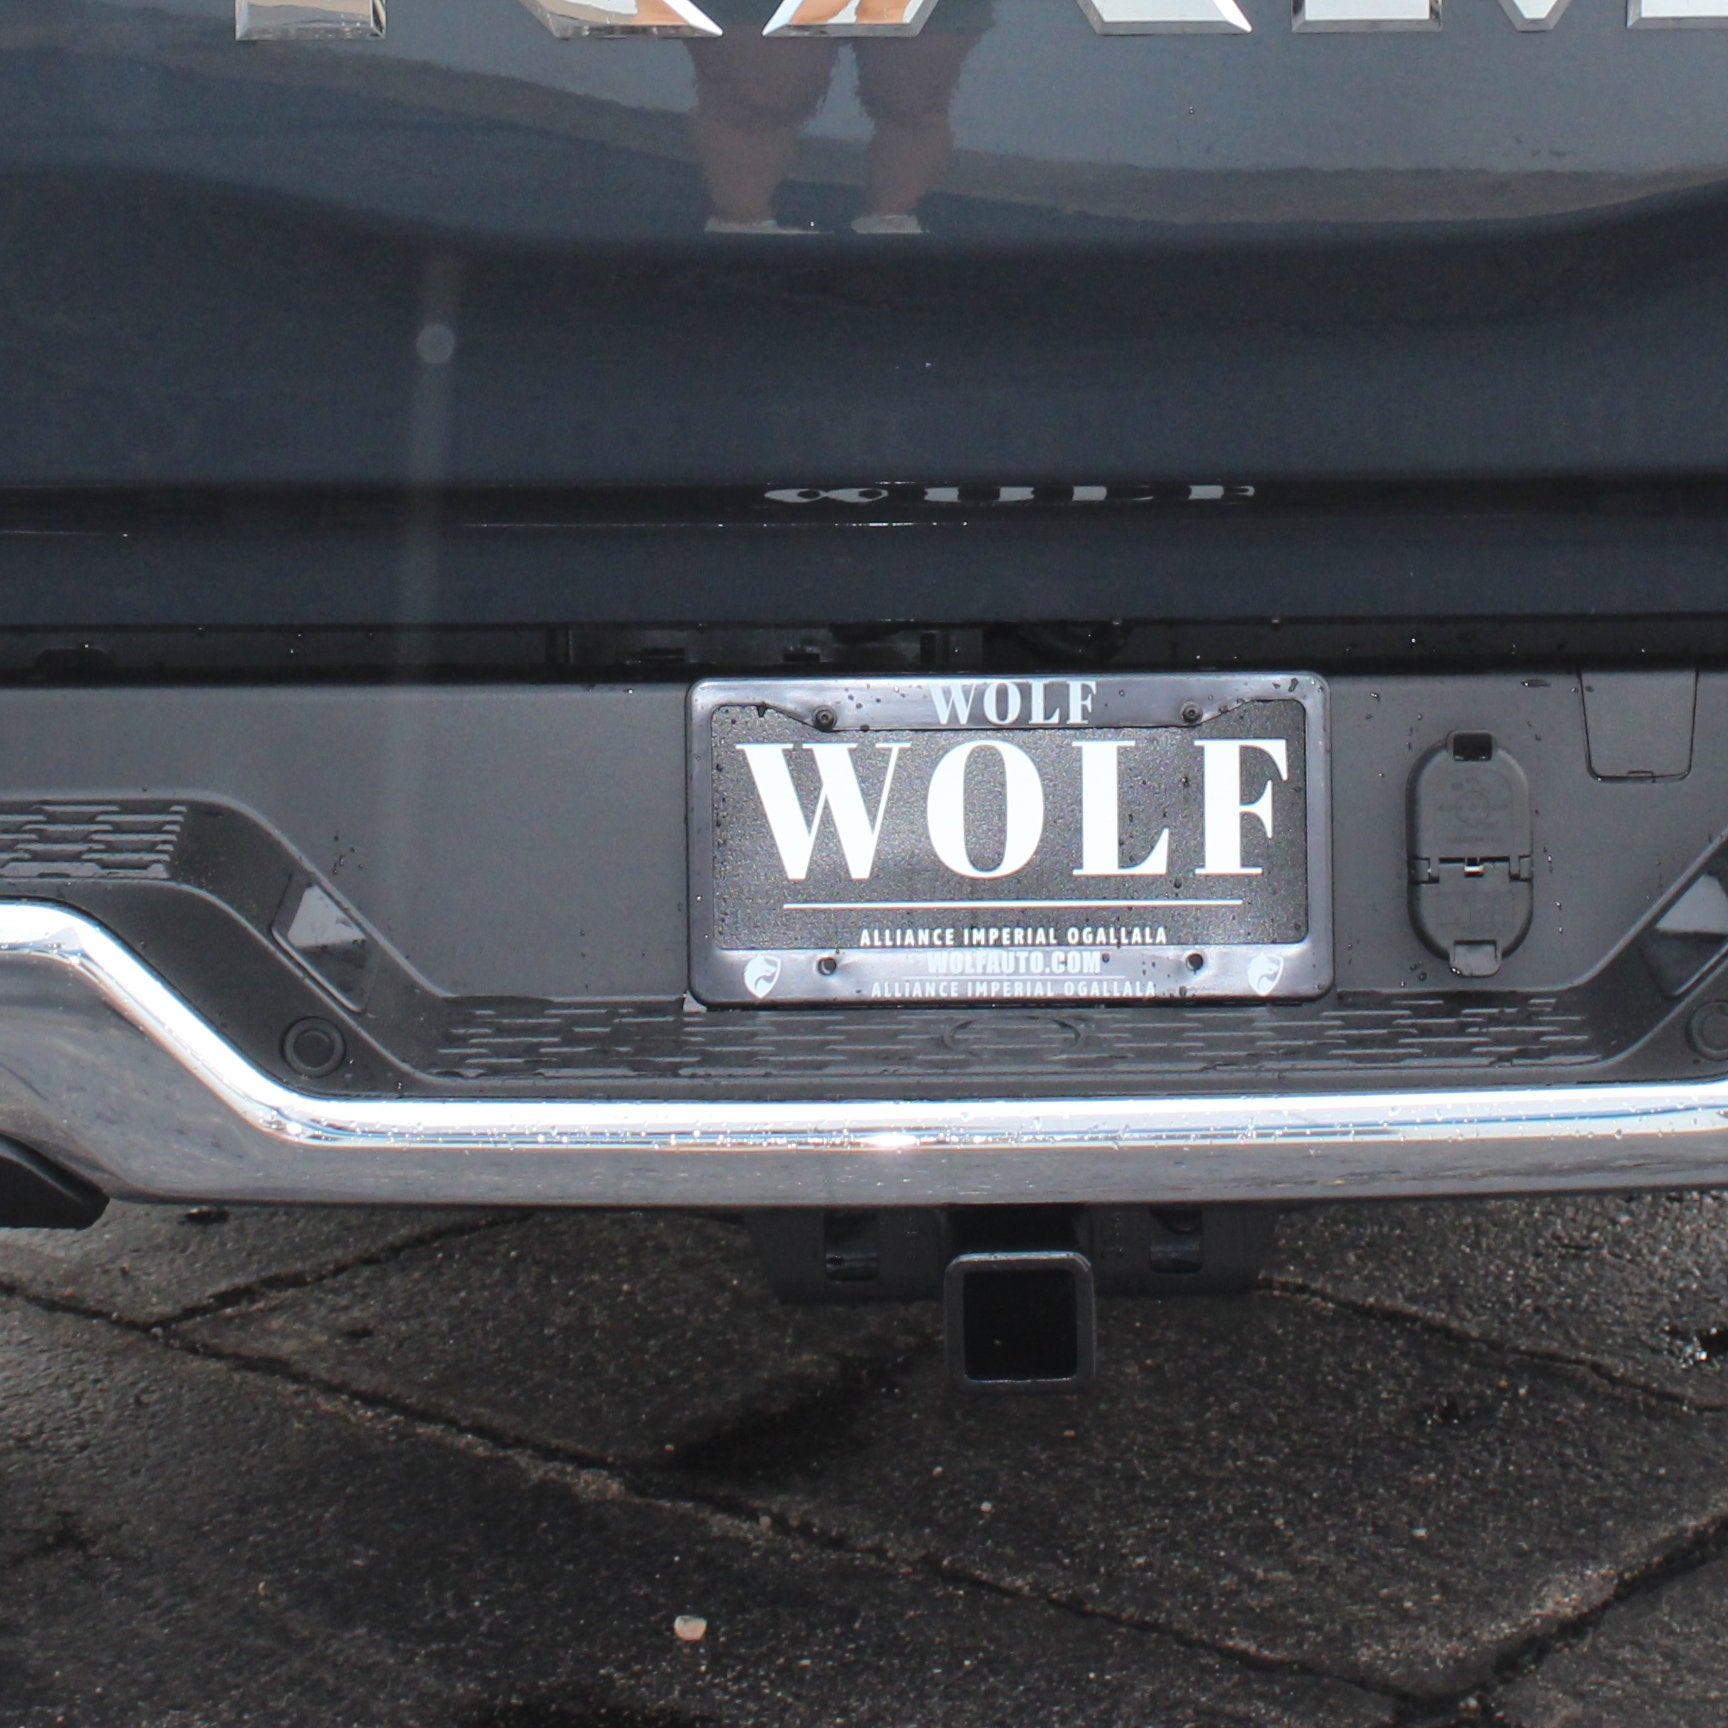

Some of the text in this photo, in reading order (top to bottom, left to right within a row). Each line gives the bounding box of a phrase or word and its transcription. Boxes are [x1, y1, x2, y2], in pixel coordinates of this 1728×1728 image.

[929, 680, 1097, 725] WOLF
[734, 738, 1289, 880] WOLF
[860, 926, 1167, 946] ALLIANCE IMPERIAL OGALLALA
[927, 950, 1102, 974] WOLFAUTO.COM
[871, 979, 1156, 998] ALLIANCE IMPERIAL OGALLALA
